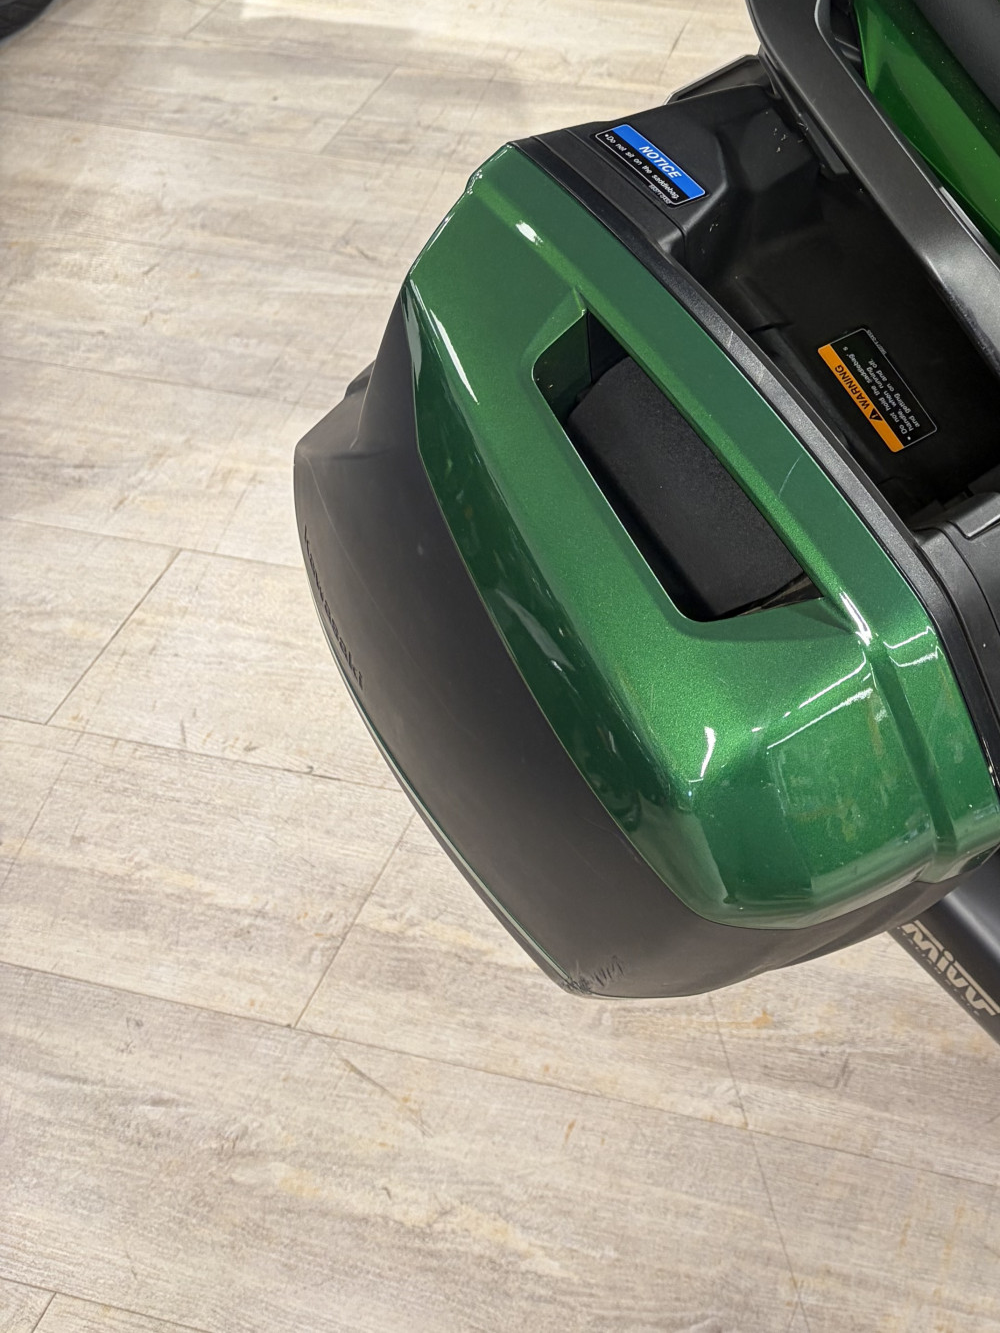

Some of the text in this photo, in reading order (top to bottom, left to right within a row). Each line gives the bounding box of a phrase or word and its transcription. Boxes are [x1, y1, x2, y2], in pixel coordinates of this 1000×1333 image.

[616, 143, 627, 151] not
[625, 149, 635, 158] sit
[634, 158, 642, 166] on
[642, 165, 652, 174] the
[639, 146, 682, 178] NOTICE
[866, 367, 884, 389] running
[876, 370, 888, 382] and
[835, 364, 870, 409] WARNING
[871, 385, 880, 396] the
[886, 383, 894, 392] on
[879, 397, 891, 411] hold
[883, 391, 897, 407] when
[894, 393, 912, 414] getting
[890, 412, 900, 423] not
[908, 415, 920, 428] and
[899, 425, 907, 435] Do
